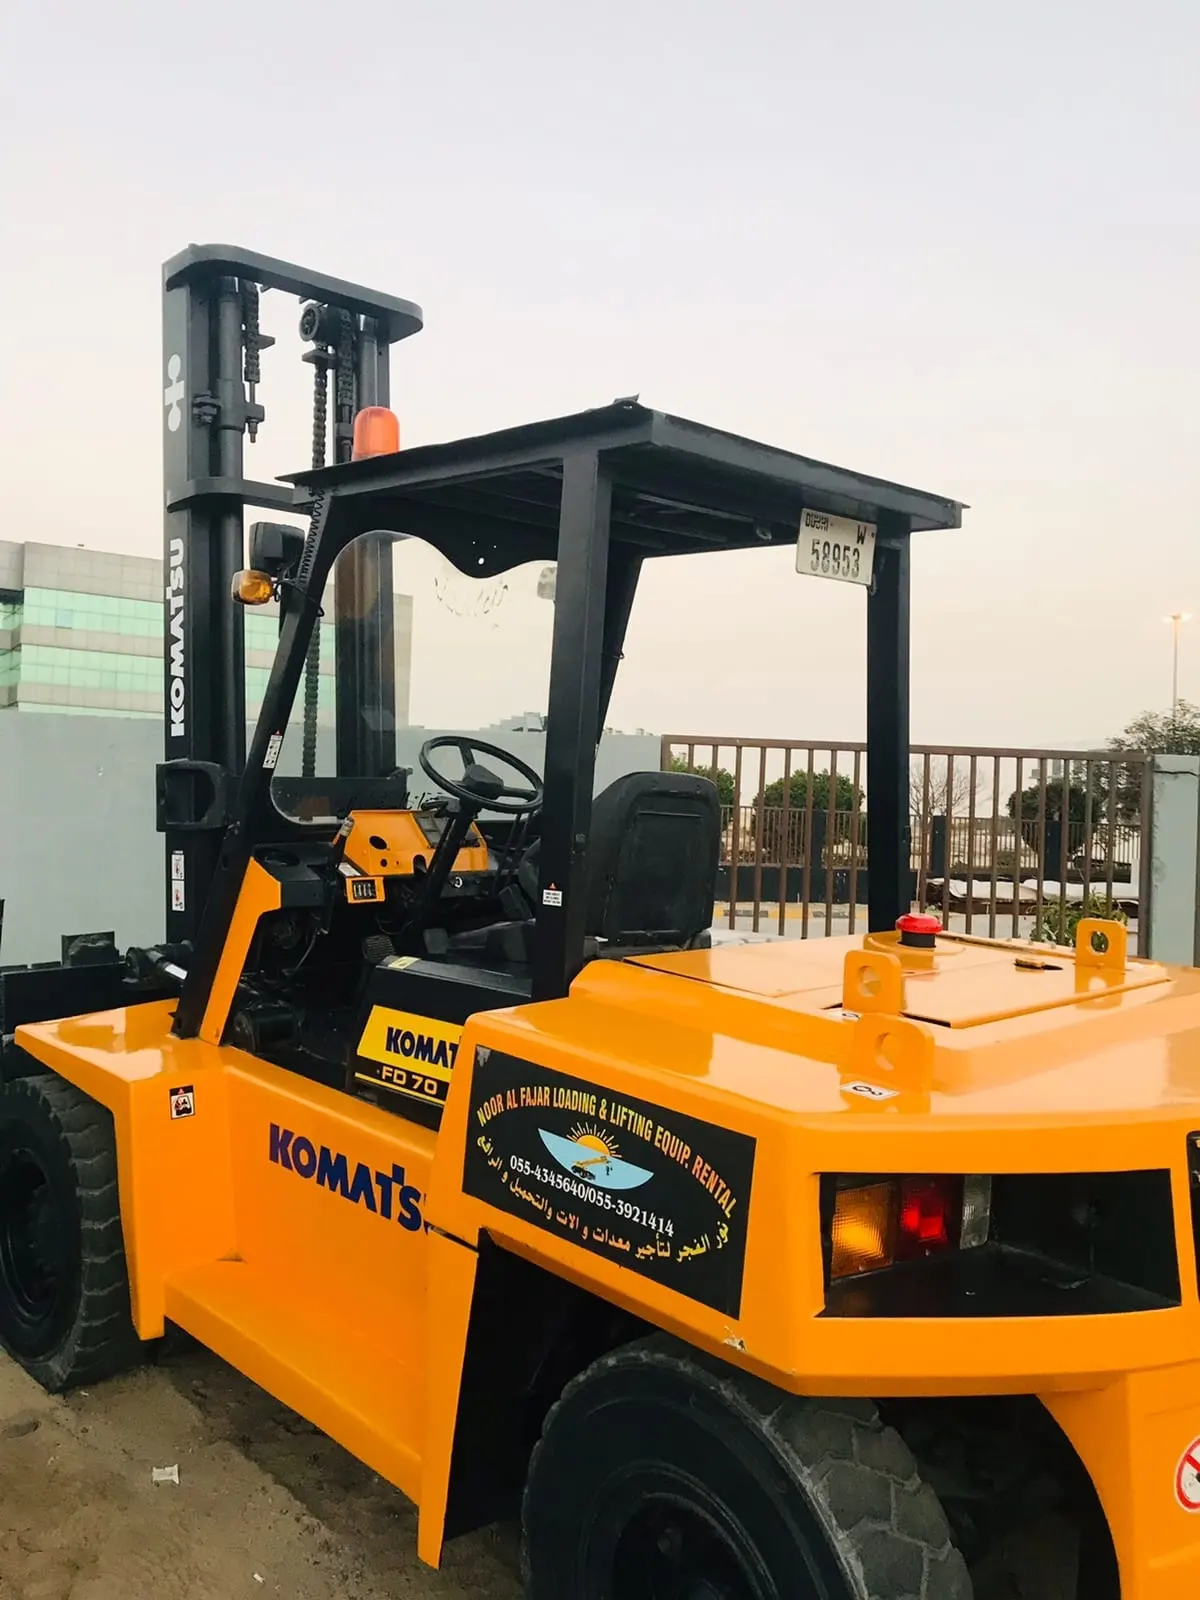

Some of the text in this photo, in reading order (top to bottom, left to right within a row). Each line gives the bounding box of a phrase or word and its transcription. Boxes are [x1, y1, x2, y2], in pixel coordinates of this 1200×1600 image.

[856, 524, 867, 545] W
[810, 538, 860, 579] 58953
[166, 537, 185, 738] KOMATSU
[382, 1065, 438, 1095] FD 70
[476, 1086, 737, 1219] NOOR AL FAJAR LOADING & LIFTING EQUIP. RENTAL
[269, 1122, 428, 1235] KOMATS
[509, 1154, 674, 1238] 055-4345640/055-3921414
[592, 1227, 631, 1252] معدات
[676, 1233, 711, 1263] الفجر
[716, 1220, 729, 1249] نور
